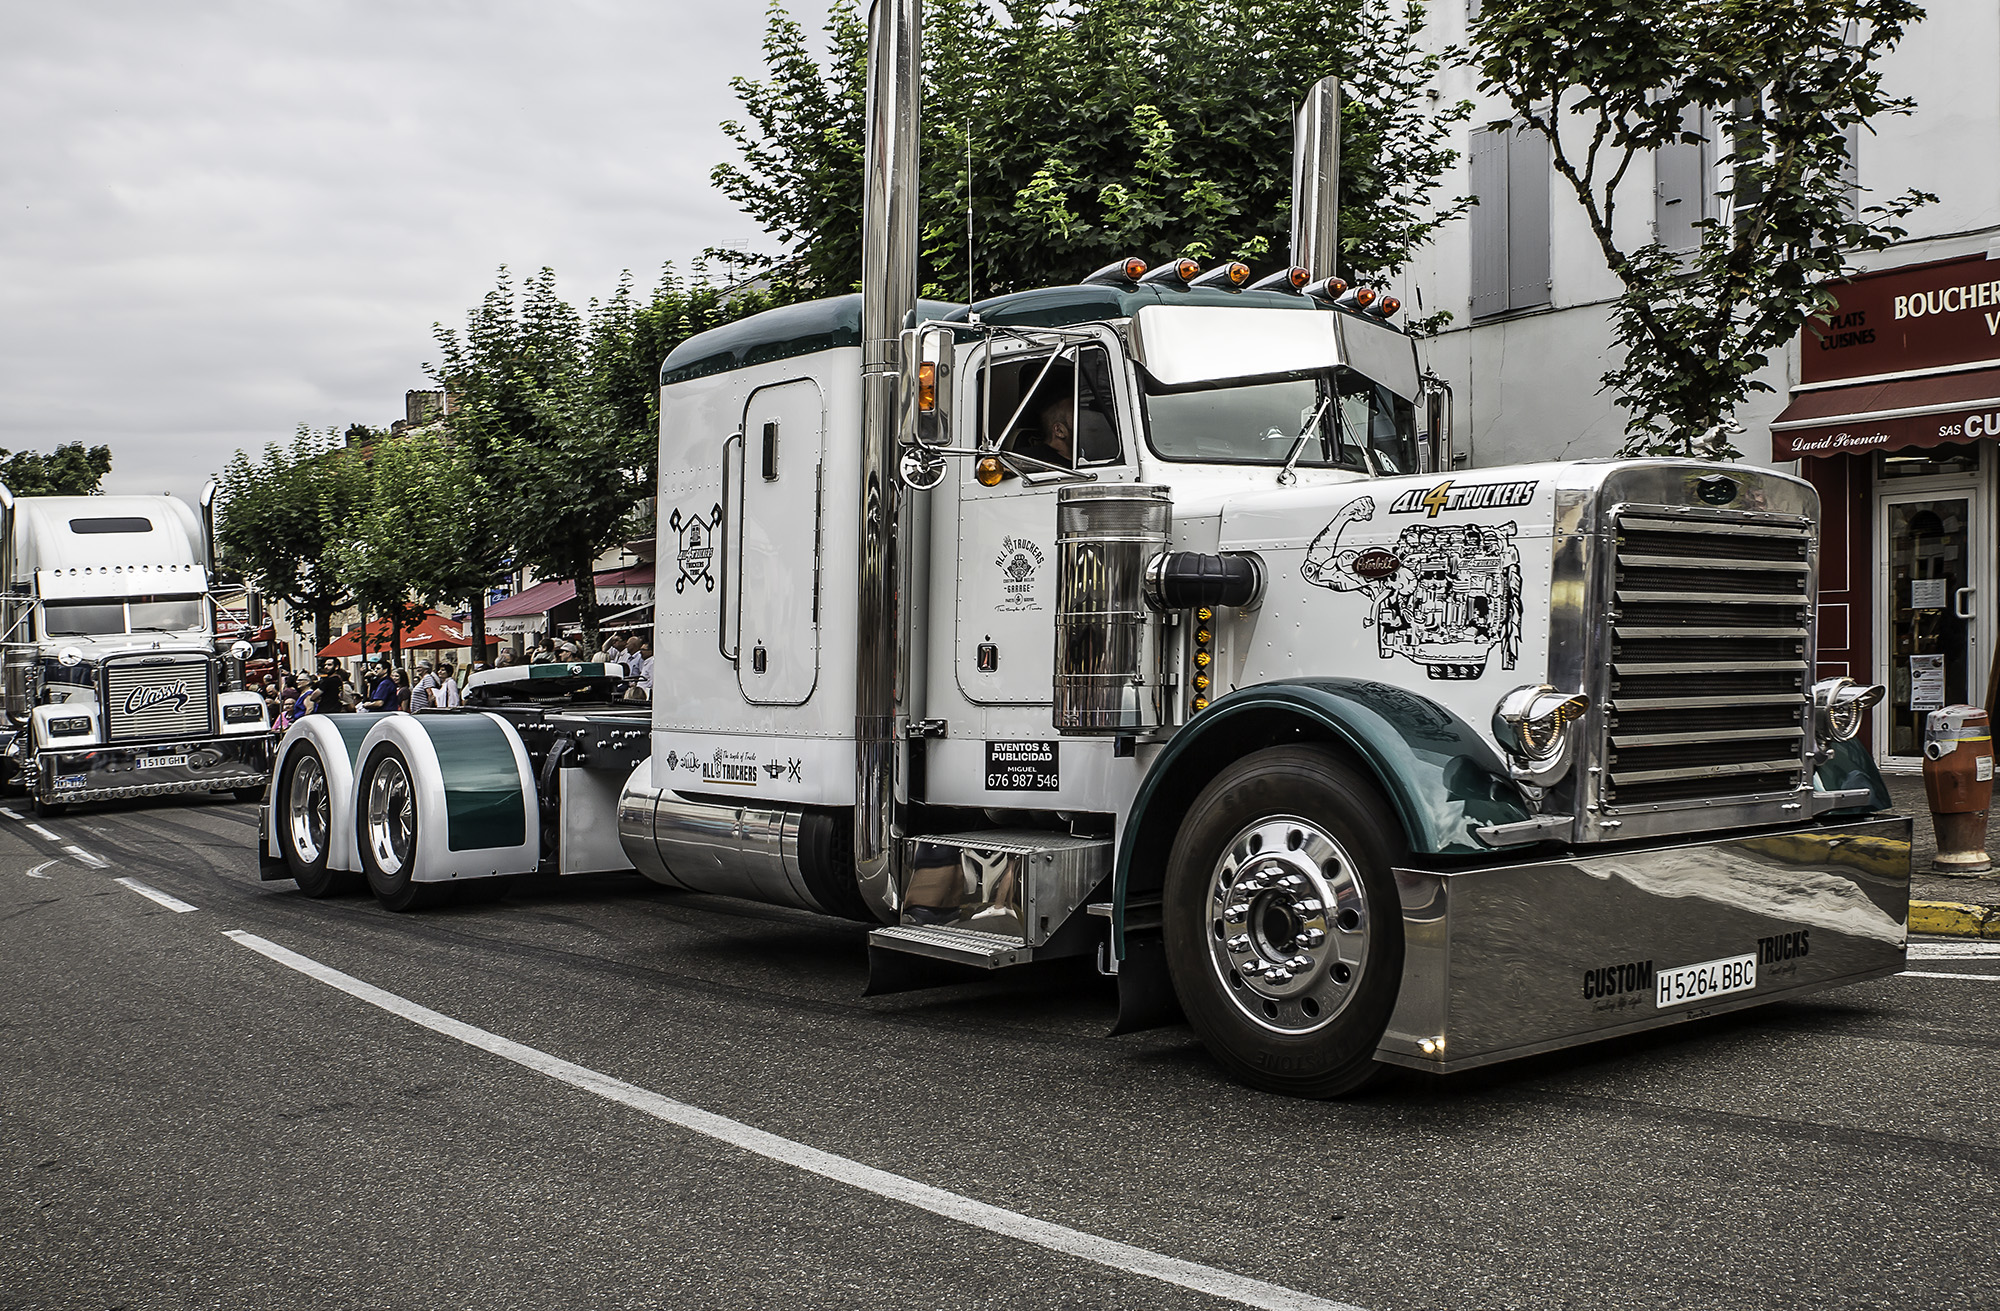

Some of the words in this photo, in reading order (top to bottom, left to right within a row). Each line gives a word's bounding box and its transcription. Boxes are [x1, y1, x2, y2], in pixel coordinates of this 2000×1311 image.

[1830, 310, 1866, 330] PLATS
[1938, 424, 1962, 437] SAS
[1791, 435, 1833, 451] David
[1013, 539, 1045, 565] TRUCKERS
[1357, 556, 1397, 571] Peterbilt
[124, 680, 189, 715] Classic
[994, 743, 1040, 752] EVENTOS
[1042, 743, 1050, 752] &
[143, 758, 165, 767] 1510
[991, 752, 1053, 761] PUBLICIDAD
[703, 762, 715, 778] ALL
[722, 764, 757, 781] TRUCKERS
[987, 773, 1009, 787] 676
[1012, 774, 1033, 787] 987
[1036, 774, 1058, 787] 546
[1757, 929, 1810, 965] TRUCKS
[1583, 960, 1653, 1000] CUSTOM
[1675, 967, 1718, 999] 5264
[1722, 960, 1754, 990] BBC
